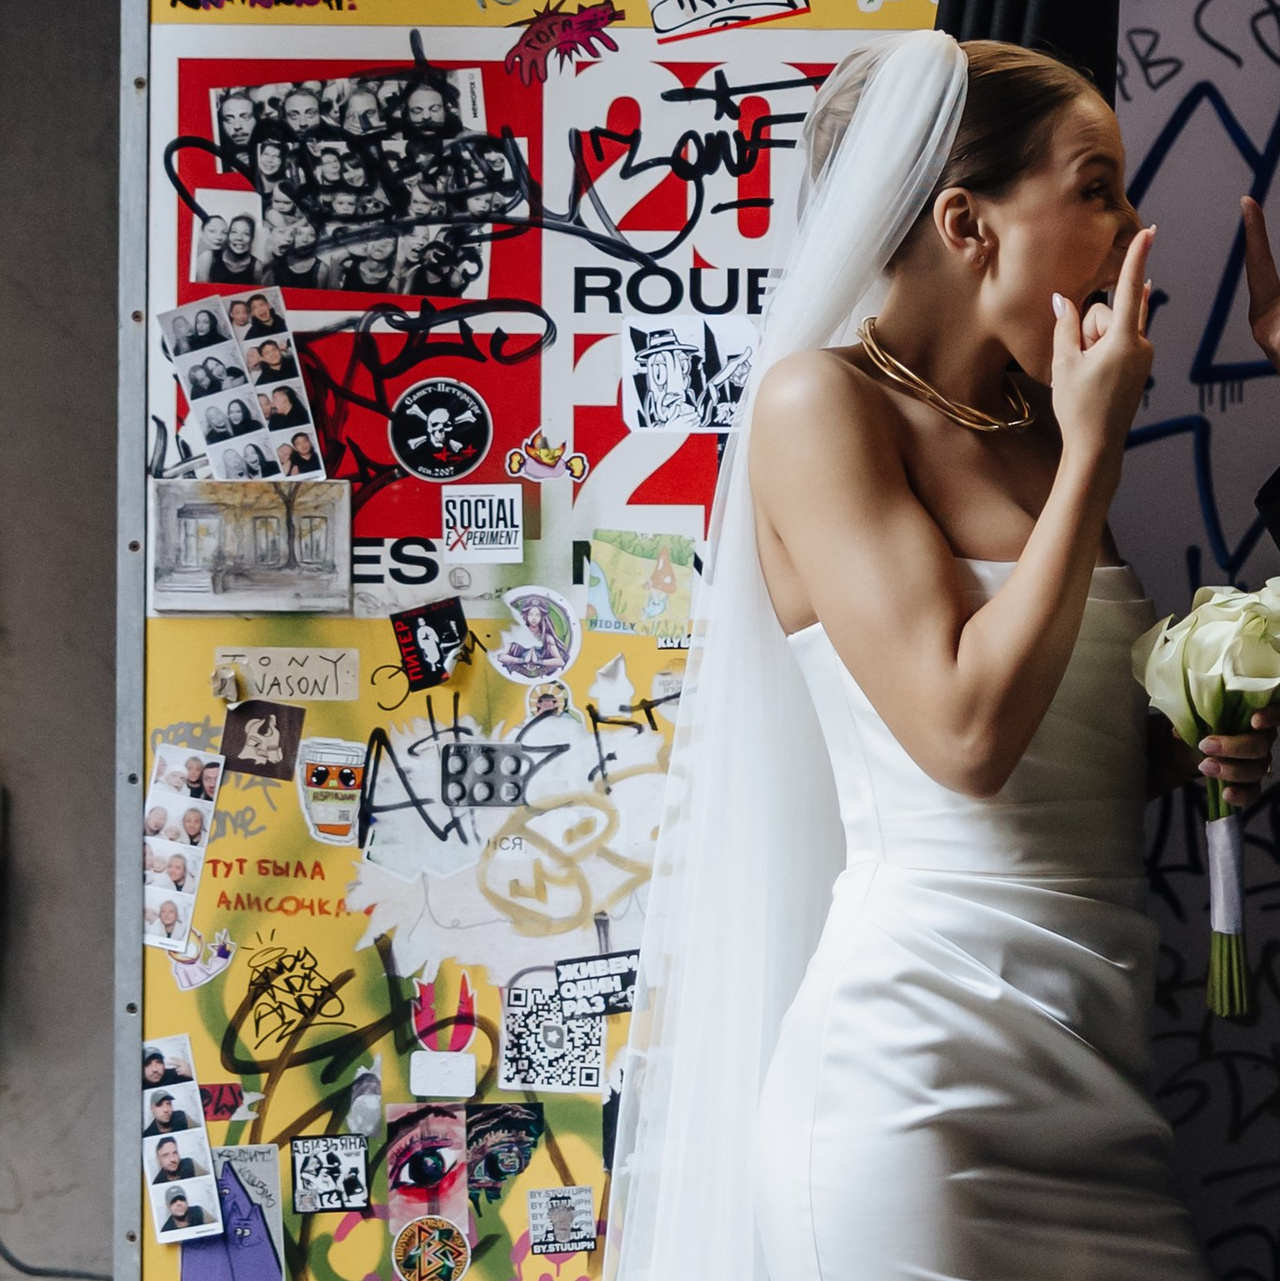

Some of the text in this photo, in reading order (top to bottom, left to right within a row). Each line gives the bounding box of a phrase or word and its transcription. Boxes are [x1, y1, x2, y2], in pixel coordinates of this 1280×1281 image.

[445, 498, 520, 530] SOCIAL
[445, 526, 520, 551] EXPERIMENT
[590, 619, 637, 631] HIDDLY
[395, 621, 424, 681] ПИТЕР
[206, 858, 326, 881] ТУТ БЫЛА
[217, 890, 352, 918] АЛИСОЧКА
[557, 954, 640, 982] ЖИВЕМ
[559, 976, 622, 1000] ОДИН
[562, 996, 606, 1017] РАЗ
